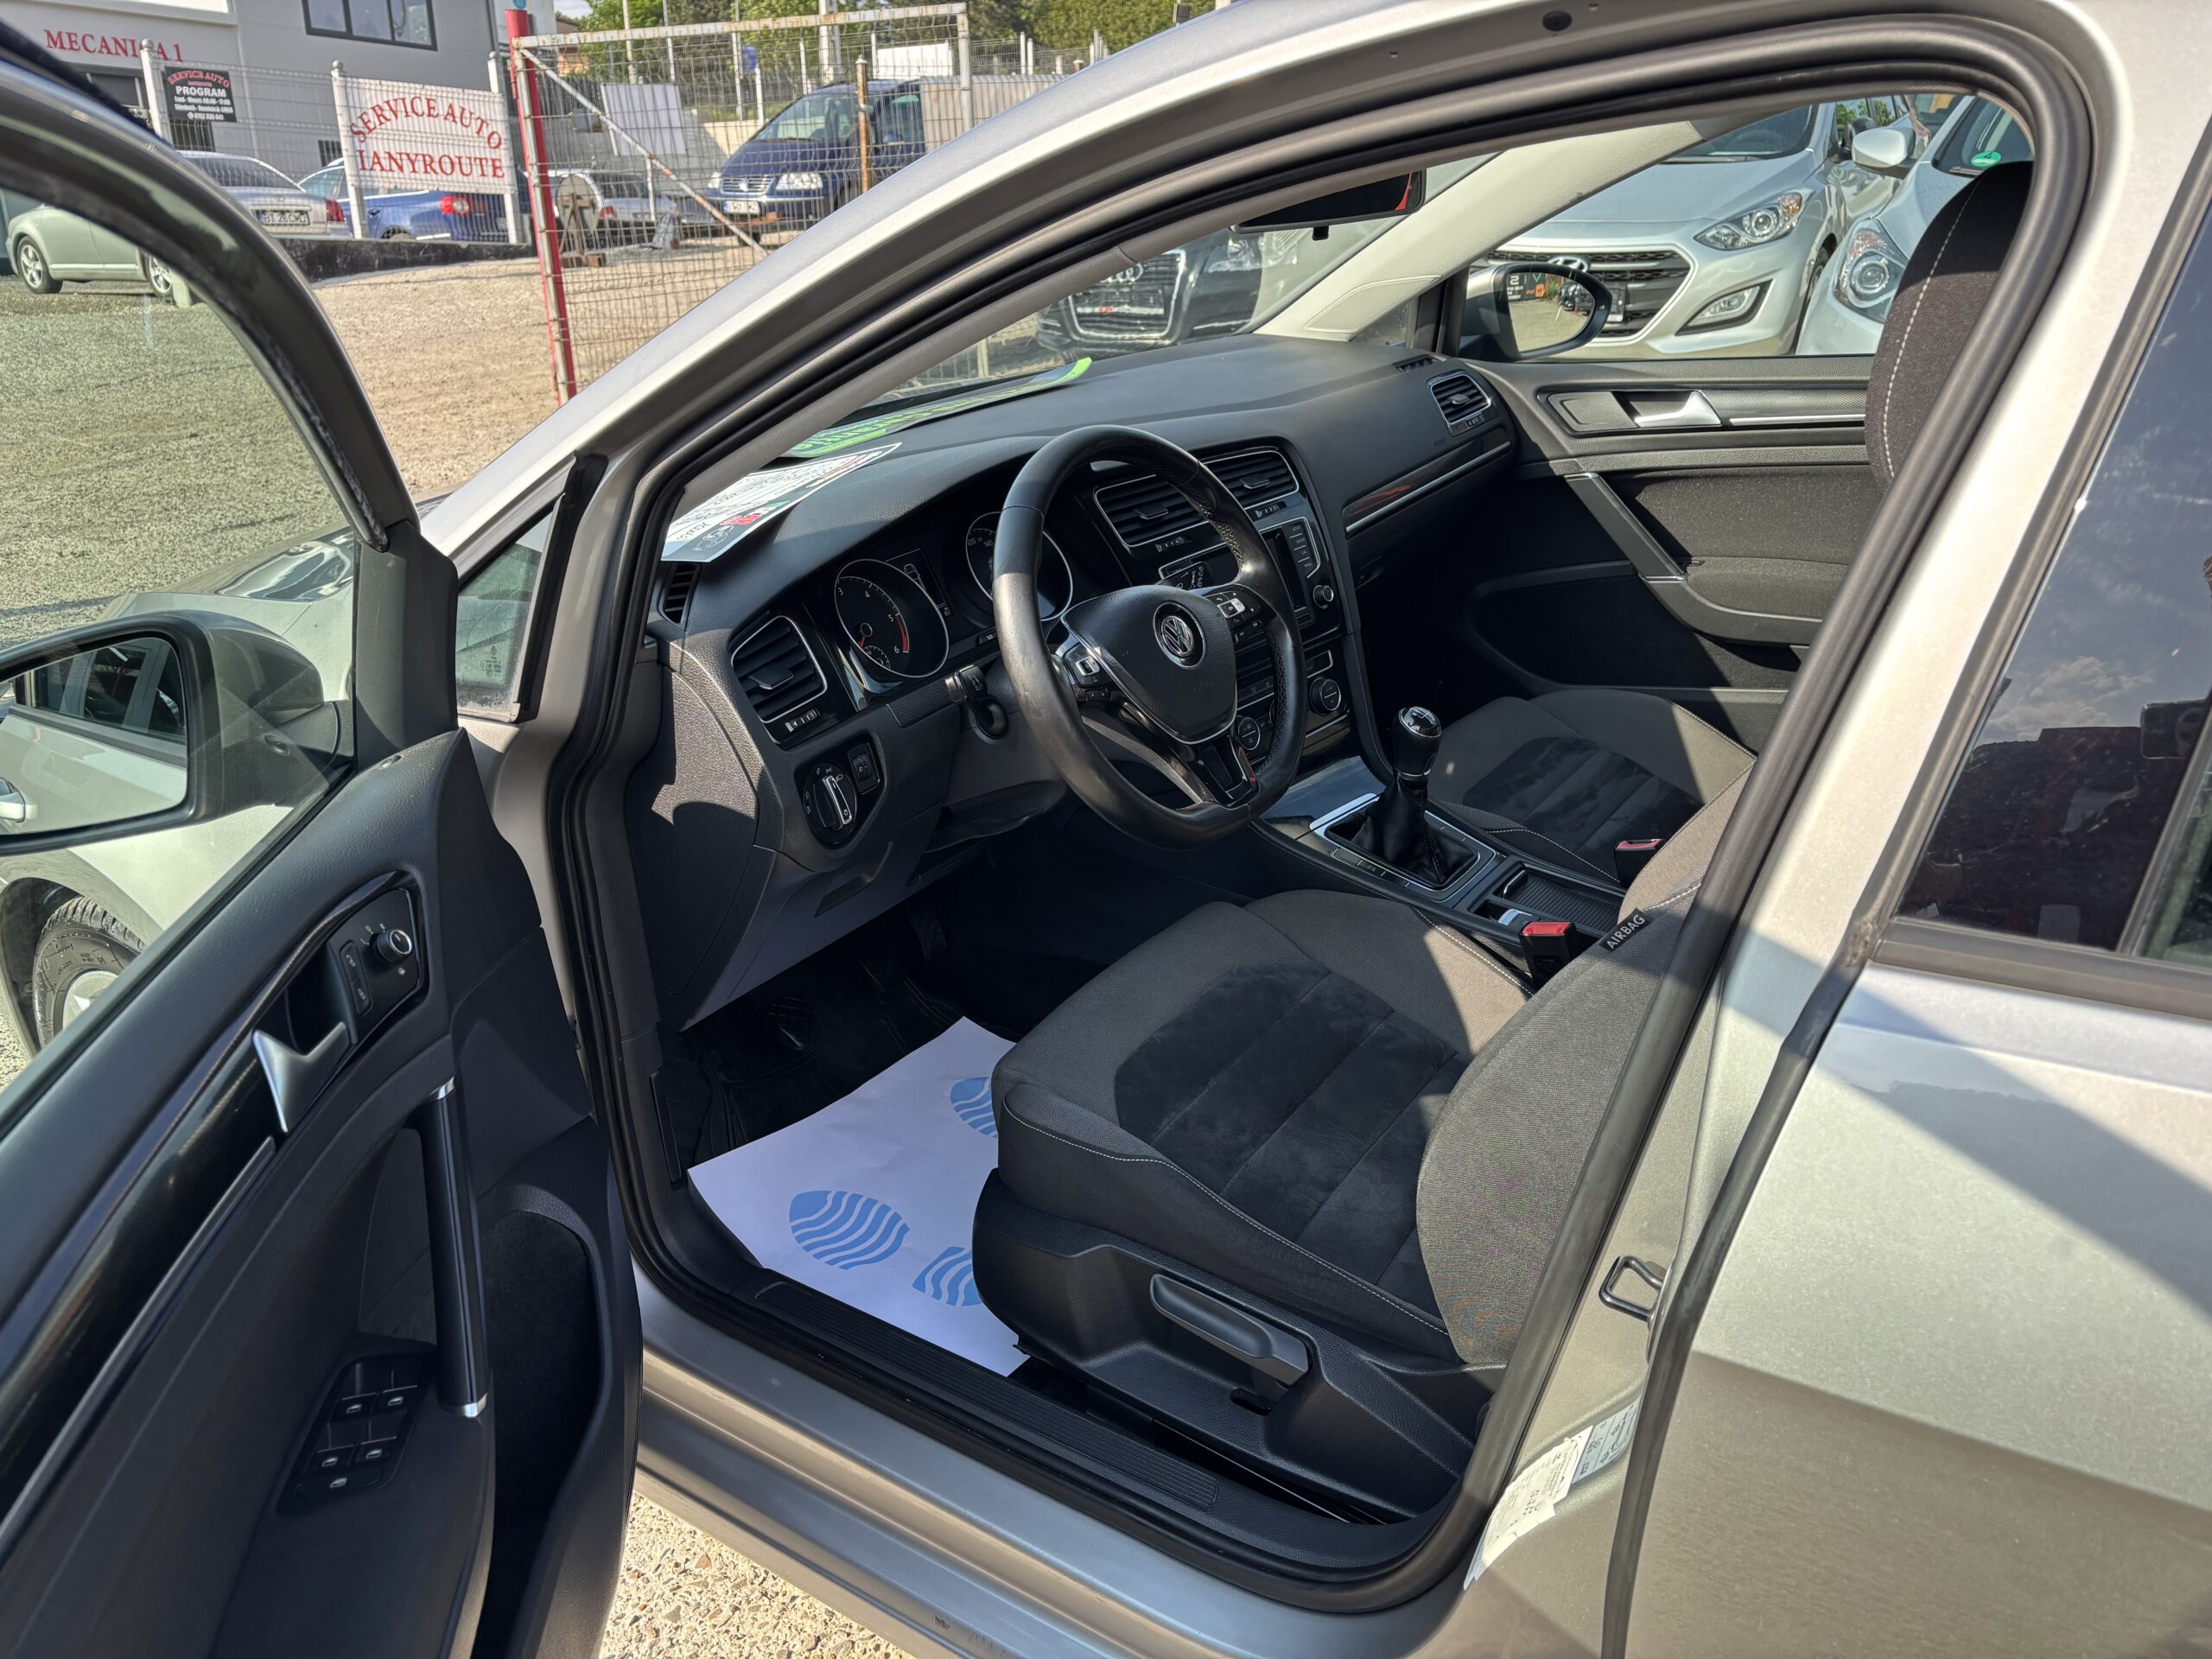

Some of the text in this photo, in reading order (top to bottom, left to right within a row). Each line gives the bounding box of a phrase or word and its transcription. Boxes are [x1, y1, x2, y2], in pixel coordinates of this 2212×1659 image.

[44, 29, 183, 62] MECANIA 1
[205, 72, 231, 87] AUTO
[175, 86, 226, 98] PROGRAM
[350, 96, 503, 149] SERVICE AUTO
[888, 613, 893, 622] 5
[1606, 914, 1645, 949] AIRBAG
